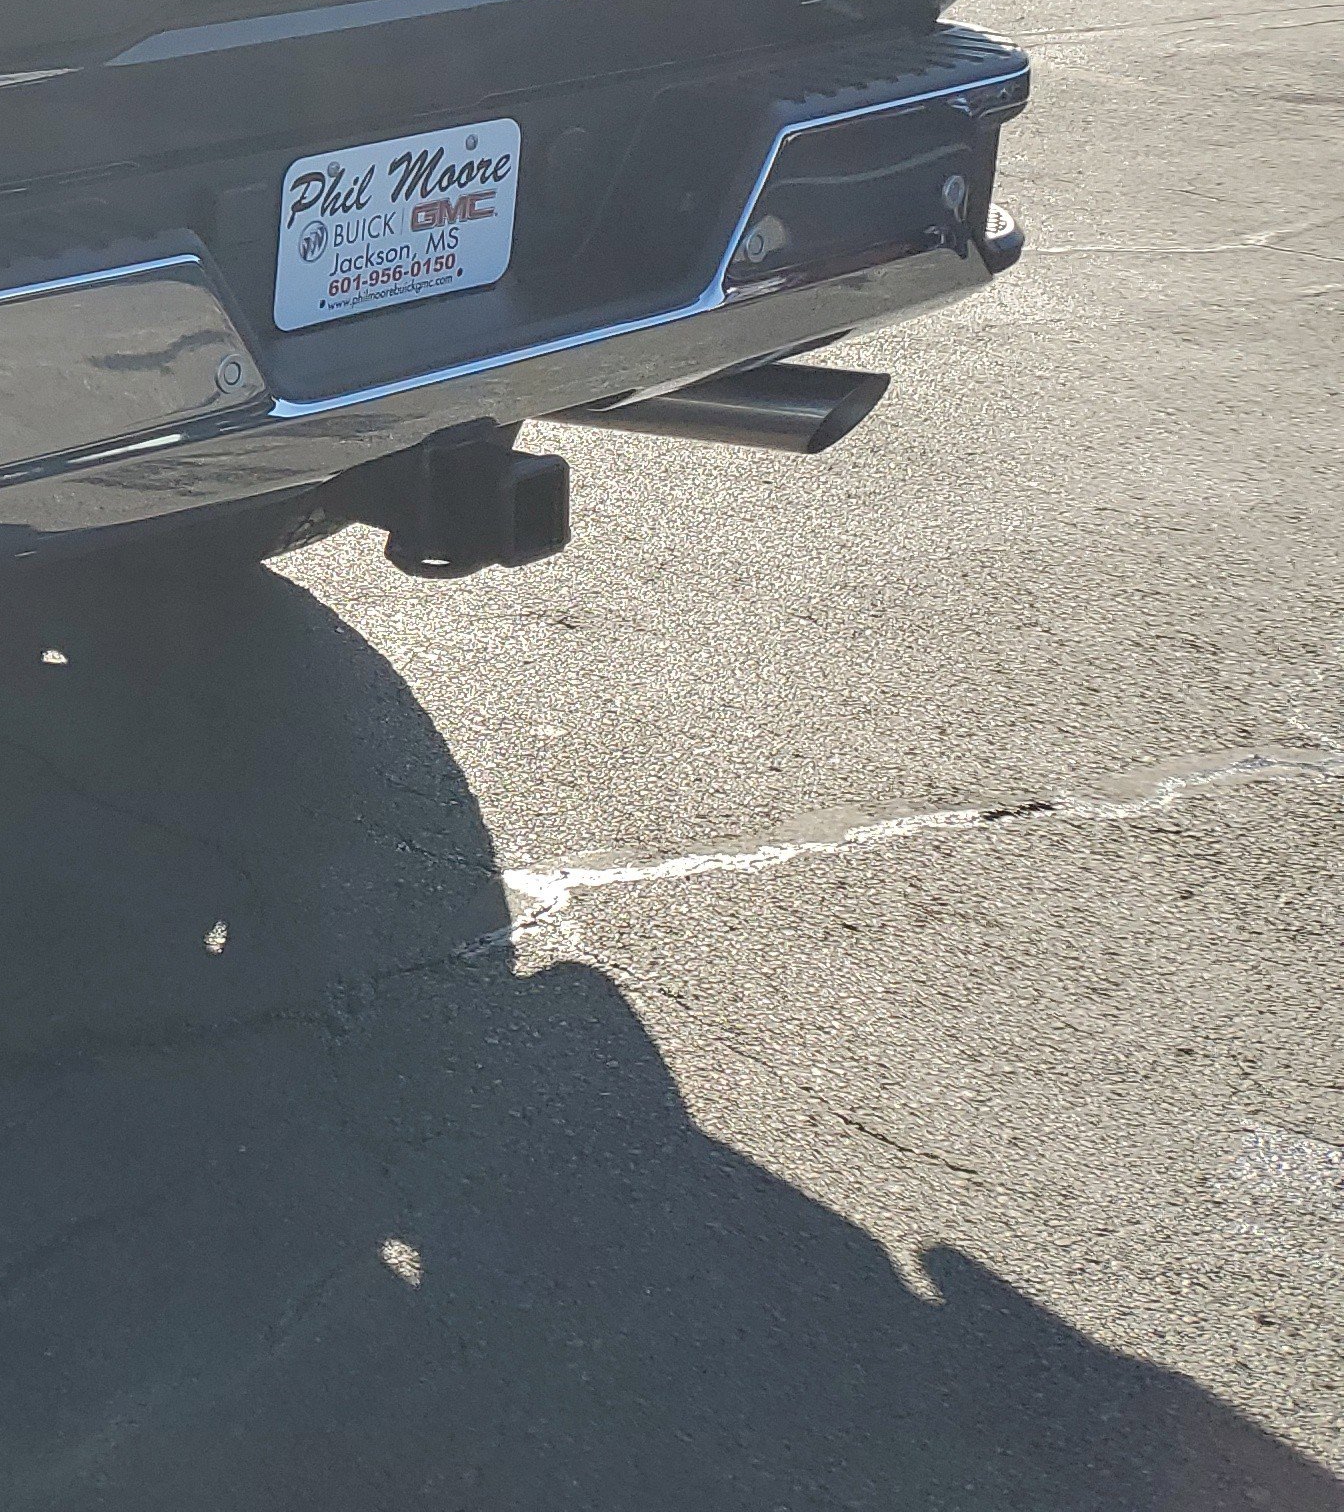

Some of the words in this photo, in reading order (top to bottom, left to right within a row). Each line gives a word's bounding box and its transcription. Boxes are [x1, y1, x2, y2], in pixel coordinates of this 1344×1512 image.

[287, 163, 376, 229] Phil
[388, 146, 512, 203] Moore
[333, 211, 396, 247] BUICK
[410, 189, 498, 232] GMC
[328, 253, 457, 297] 601-956-0150
[329, 243, 417, 277] Jackson,
[425, 227, 460, 255] MS
[327, 275, 453, 310] www.philmoorebuickgmc.com
